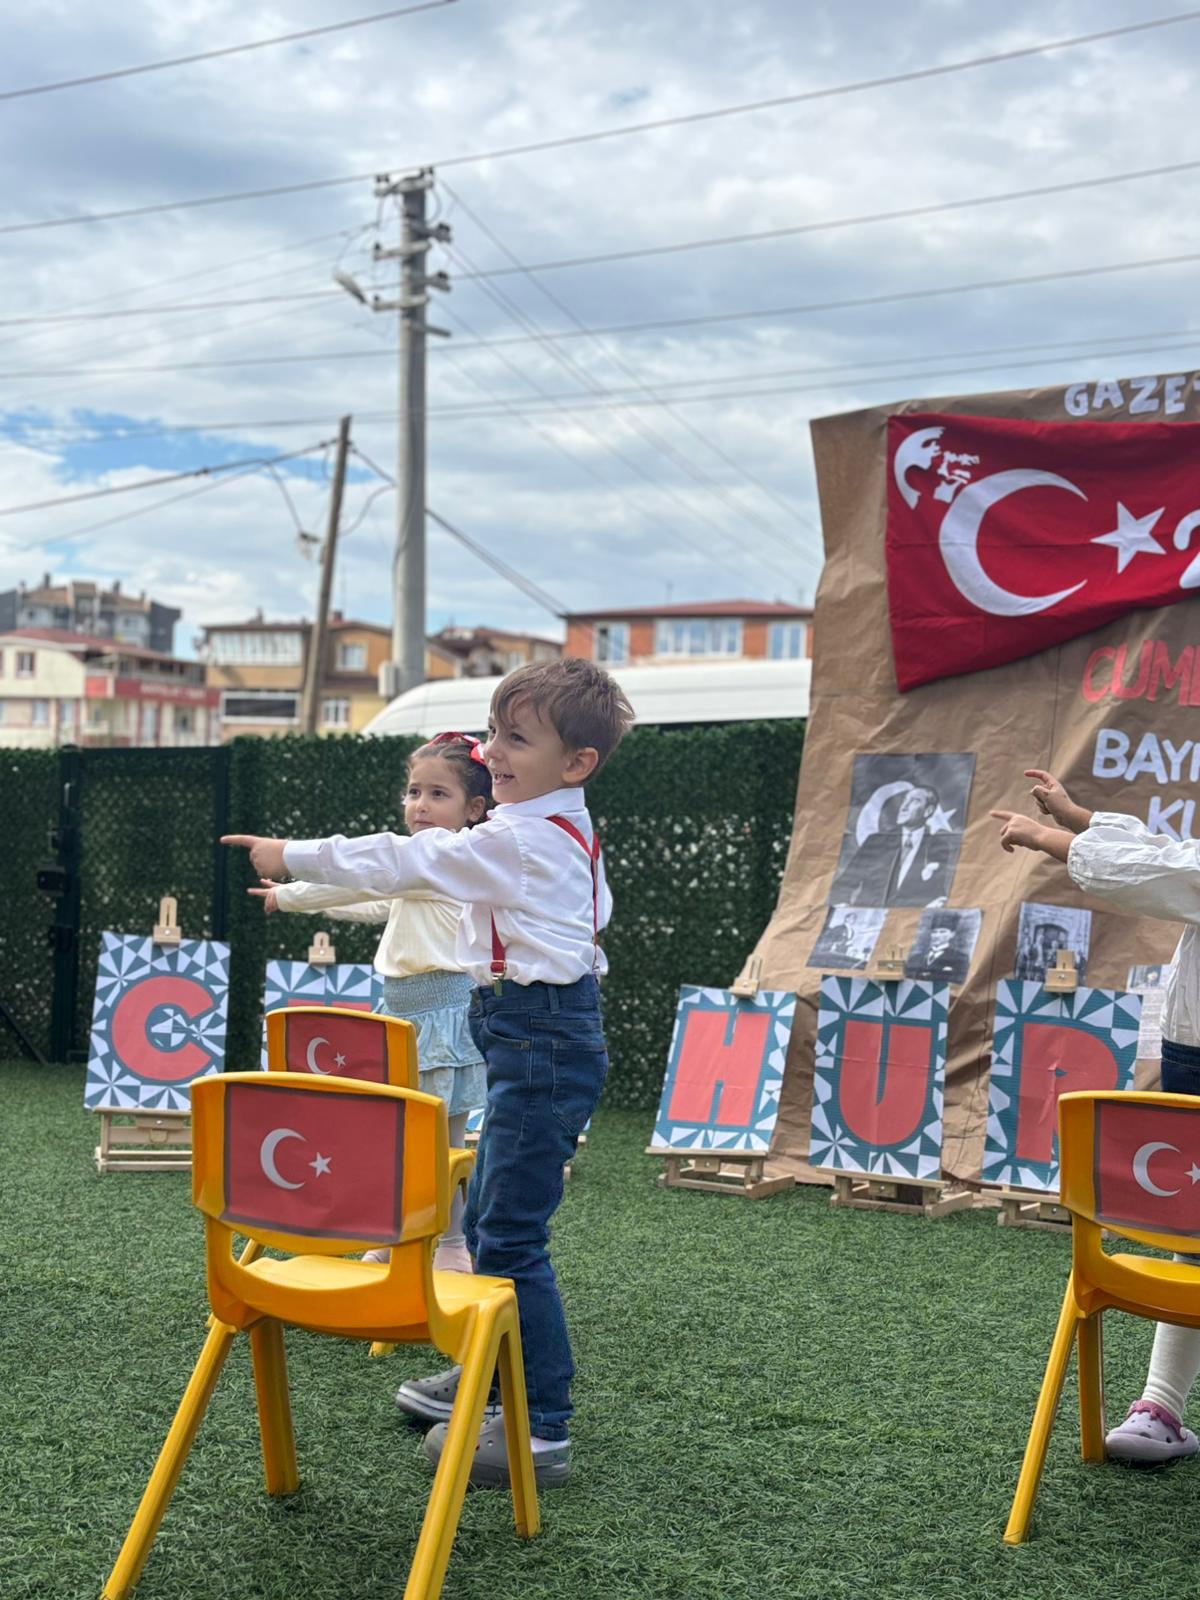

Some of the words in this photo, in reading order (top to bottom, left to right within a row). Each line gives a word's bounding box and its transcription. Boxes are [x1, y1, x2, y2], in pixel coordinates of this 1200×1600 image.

[1064, 375, 1200, 416] GAZE
[111, 975, 214, 1081] C
[667, 1008, 771, 1126] H
[839, 1020, 932, 1146] U
